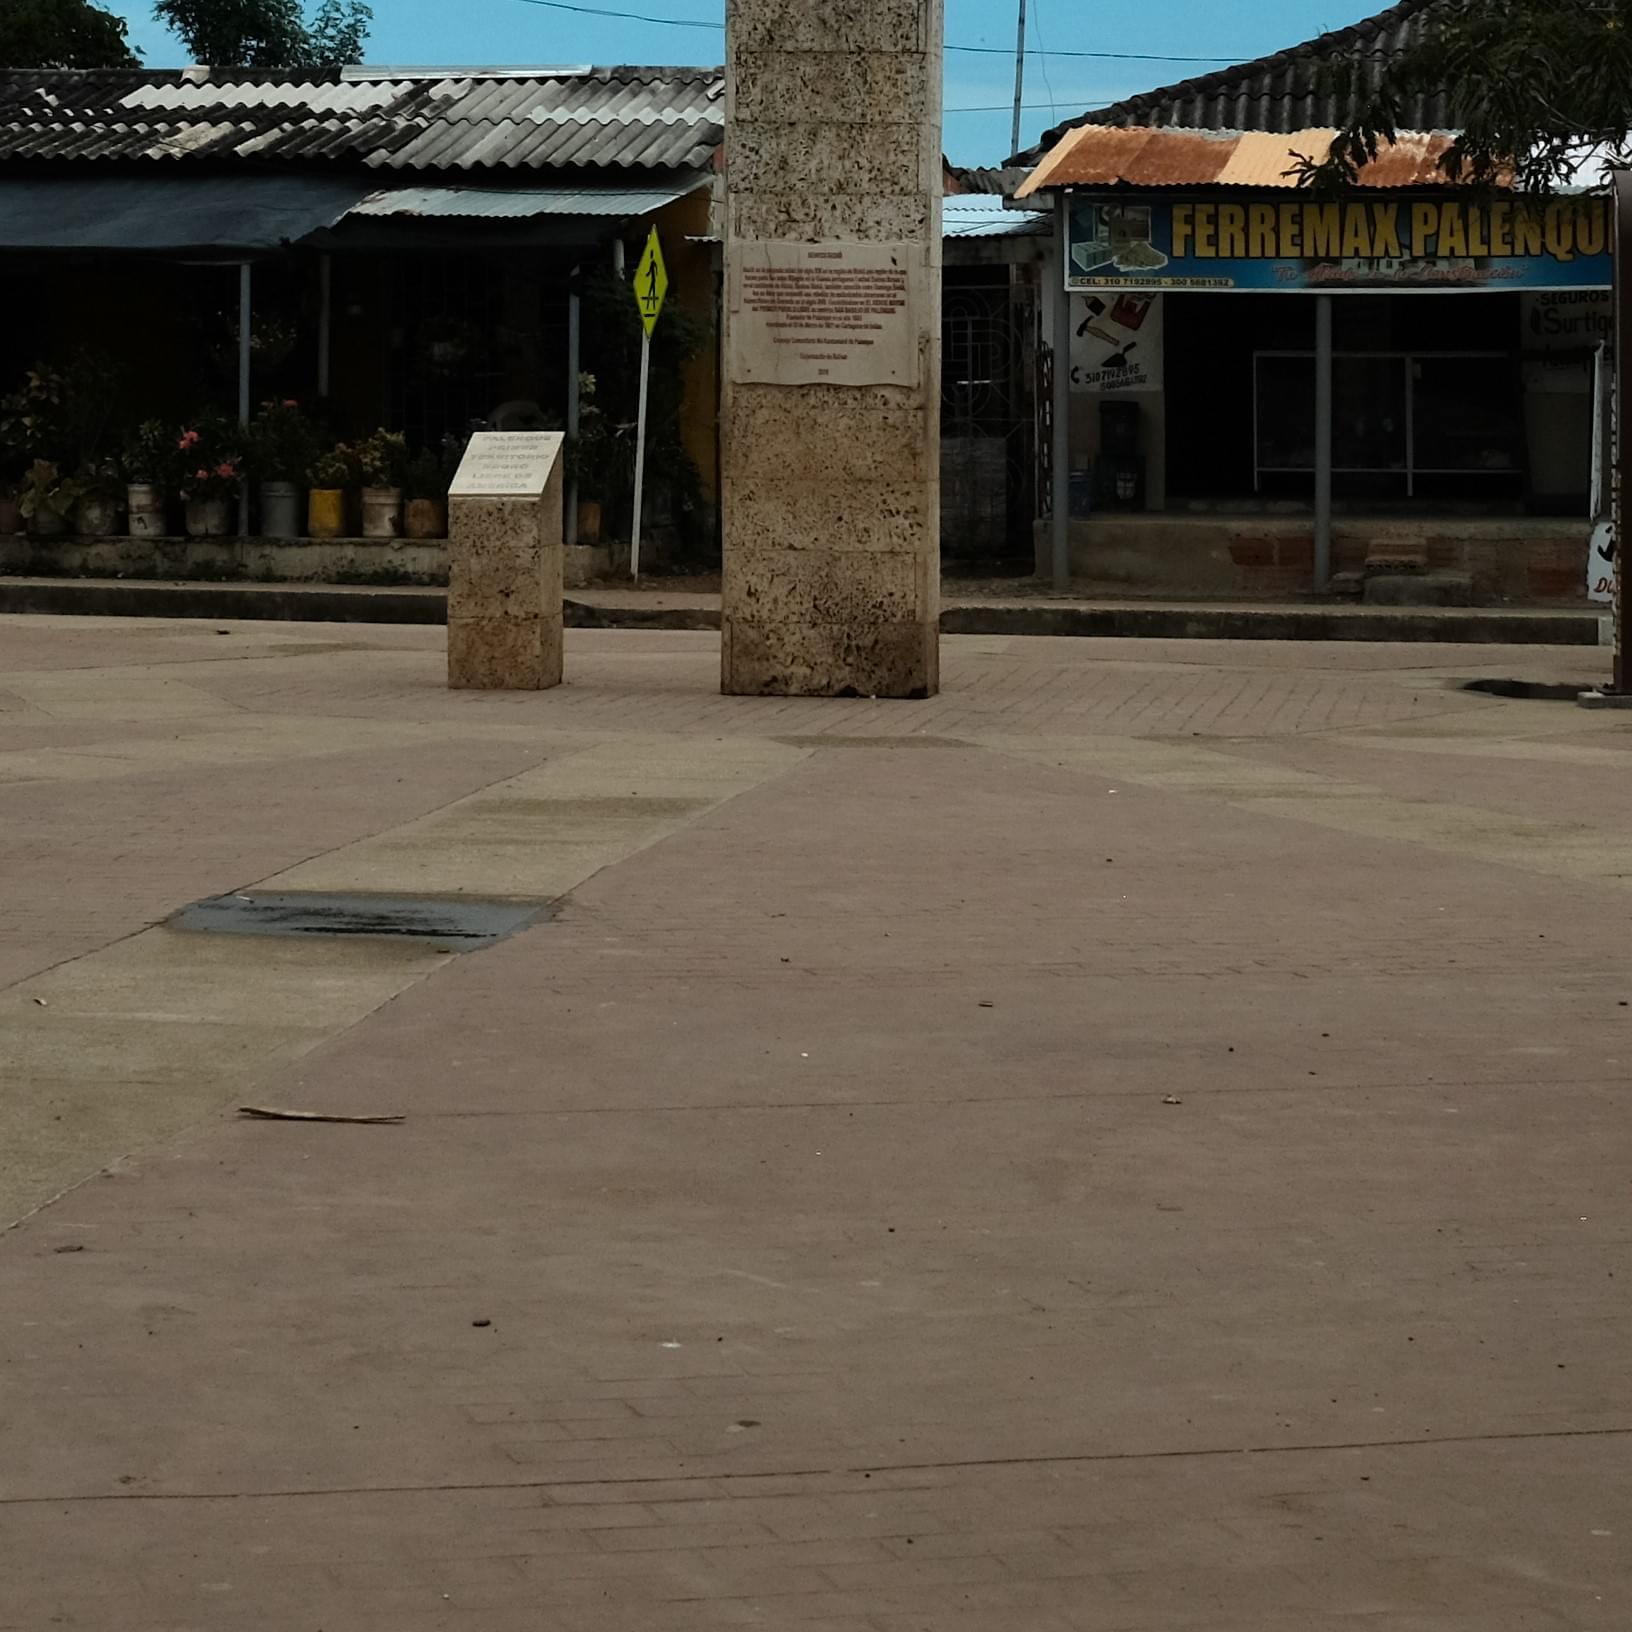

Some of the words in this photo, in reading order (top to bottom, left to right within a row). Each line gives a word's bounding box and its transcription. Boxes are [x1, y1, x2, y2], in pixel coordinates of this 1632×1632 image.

[1172, 202, 1403, 258] FERREMAX
[1411, 201, 1614, 262] PALENQU
[1104, 278, 1120, 286] 310
[1540, 291, 1609, 305] SEGUROS
